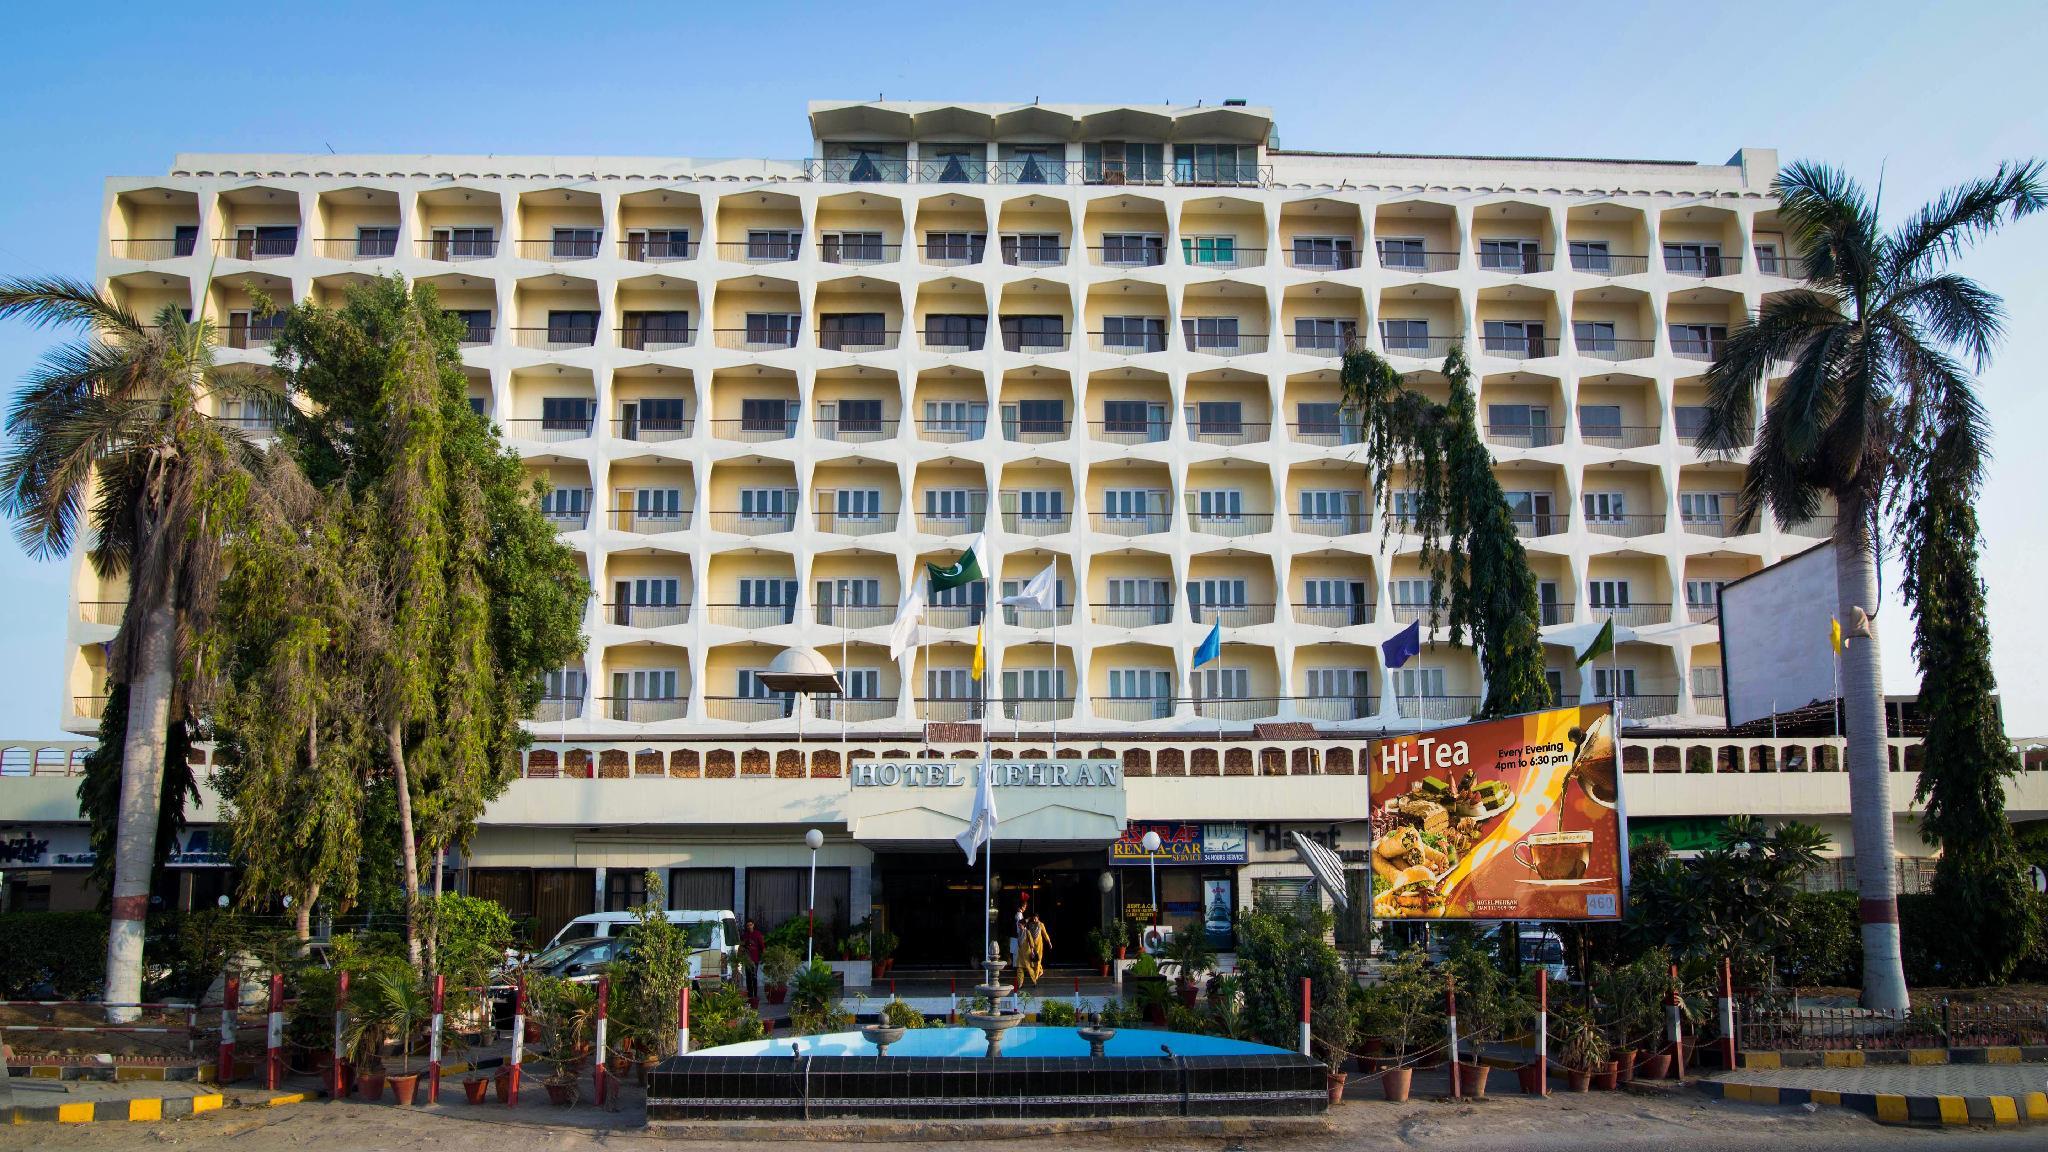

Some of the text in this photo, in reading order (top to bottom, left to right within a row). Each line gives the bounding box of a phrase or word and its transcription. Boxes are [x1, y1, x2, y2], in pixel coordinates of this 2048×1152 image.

[1381, 738, 1470, 775] Hi-Tea
[1498, 742, 1564, 758] Every Evening
[1495, 754, 1569, 772] 4pm to 6:30 pm
[855, 763, 1119, 787] HOTEL MEHRAN
[1114, 843, 1201, 855] RENA-CAR
[1172, 854, 1202, 862] SERVICE
